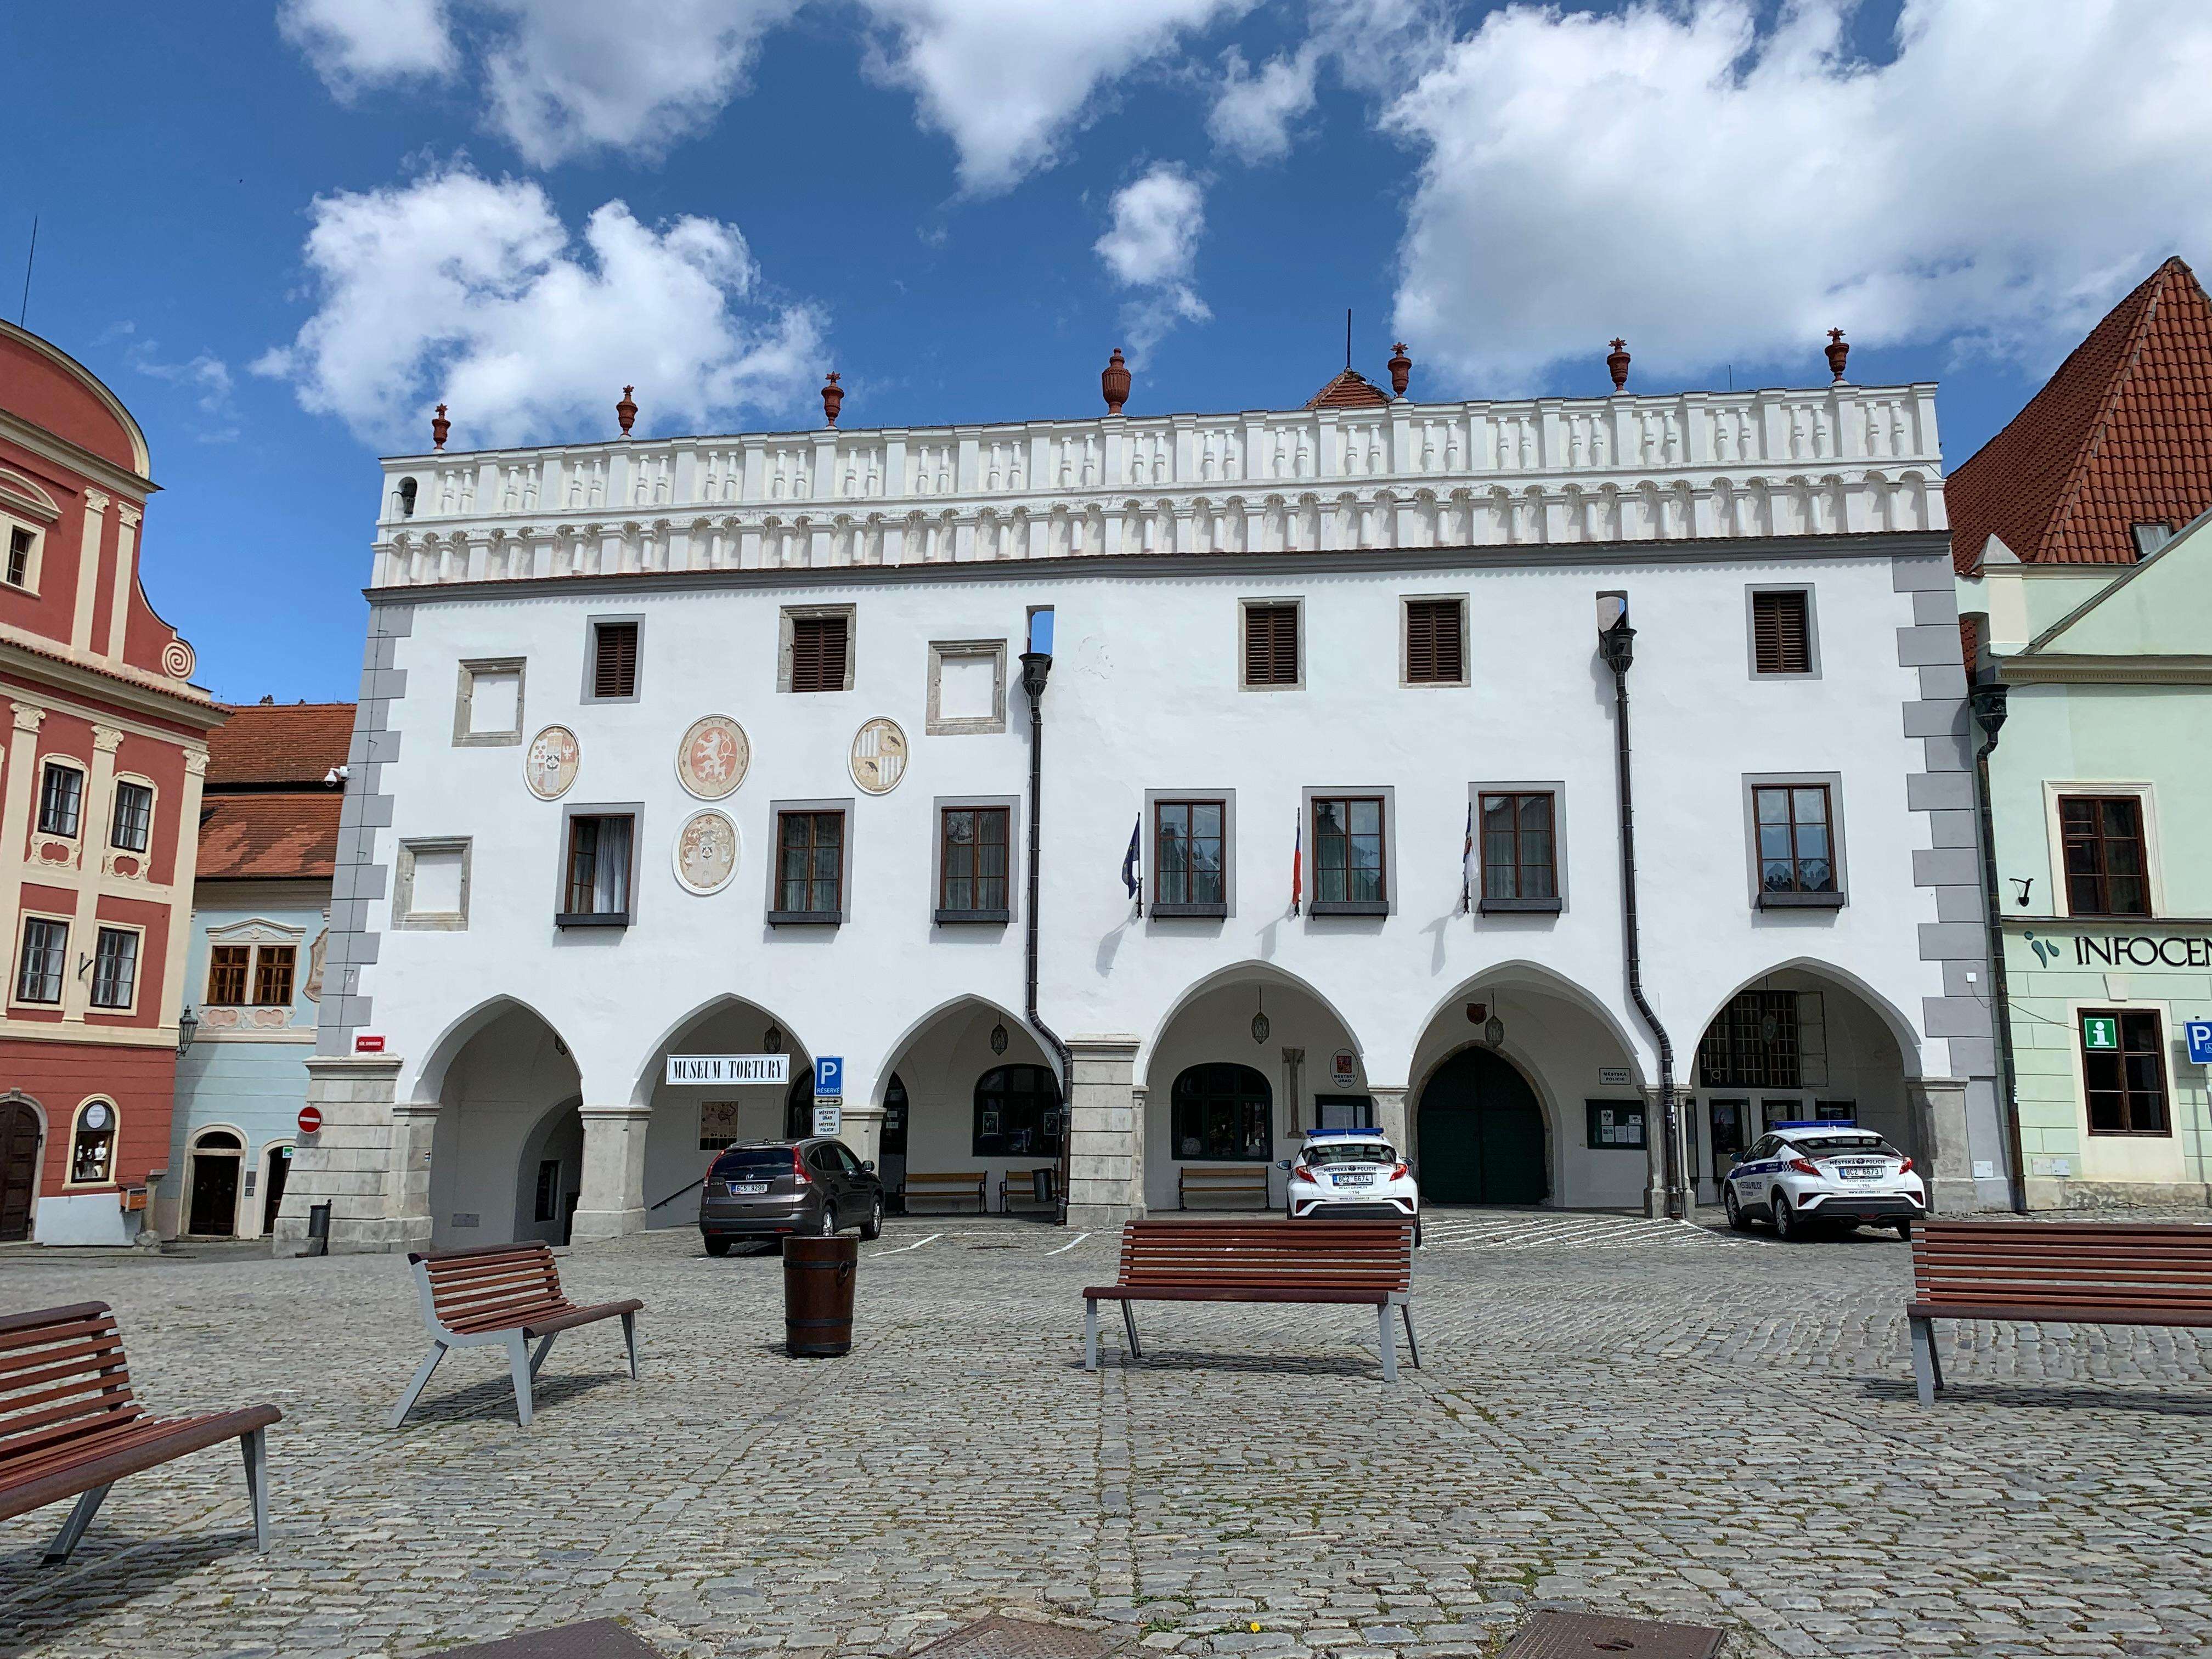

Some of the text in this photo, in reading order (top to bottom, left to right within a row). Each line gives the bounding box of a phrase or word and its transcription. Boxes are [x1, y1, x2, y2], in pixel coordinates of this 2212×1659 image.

[2192, 1025, 2211, 1050] P
[673, 1060, 783, 1079] MUSEUM TORTURY
[821, 1062, 837, 1084] P
